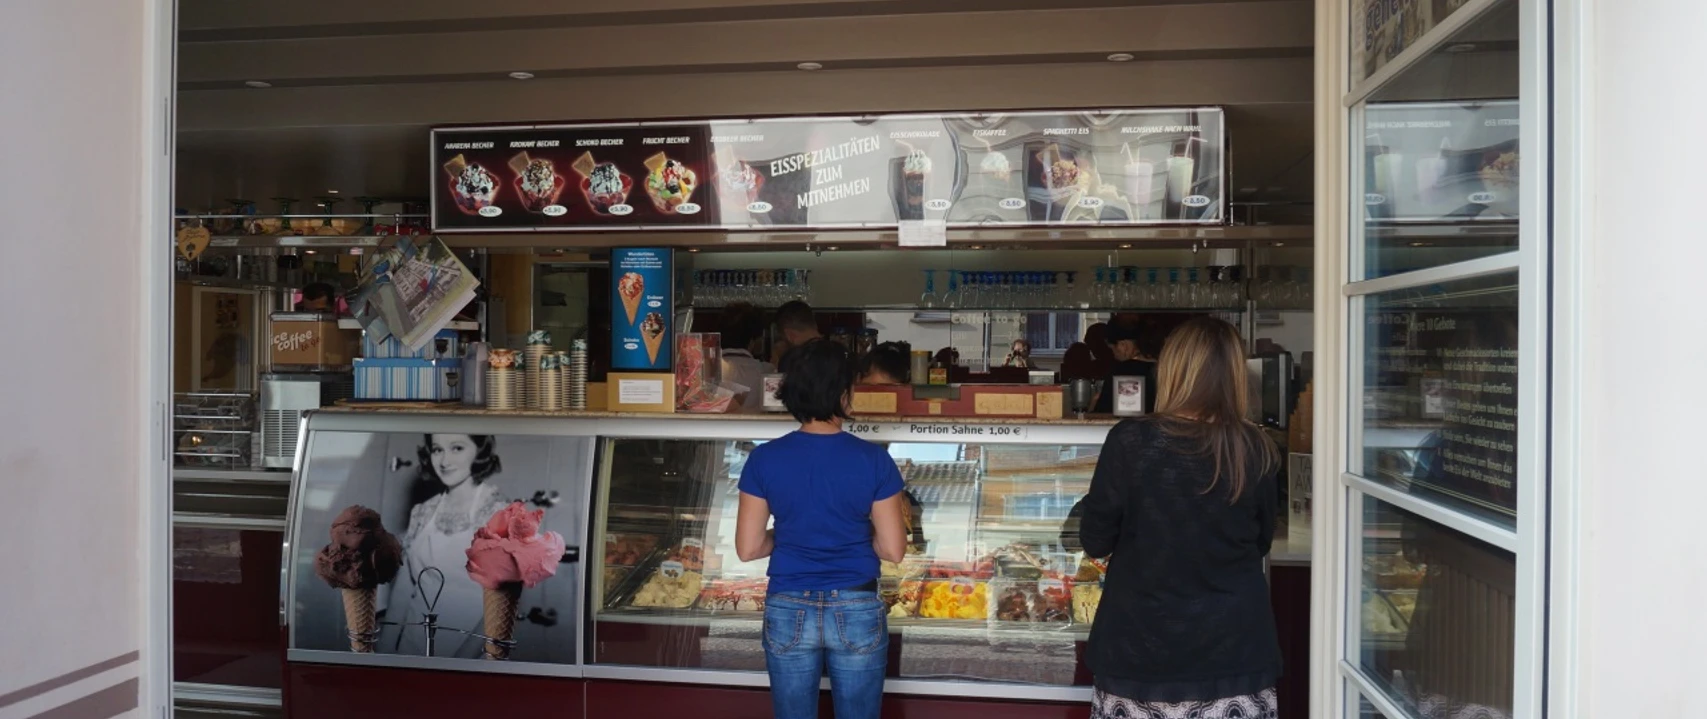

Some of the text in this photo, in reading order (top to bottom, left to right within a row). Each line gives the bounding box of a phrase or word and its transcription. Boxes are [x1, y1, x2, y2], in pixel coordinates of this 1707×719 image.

[1078, 127, 1090, 135] EIS
[642, 136, 690, 145] FRUCHT BECHER
[770, 134, 881, 177] EISSPEZIALITÄTEN
[816, 164, 843, 186] ZUM
[797, 177, 870, 209] MITNEHMEN
[951, 314, 990, 324] Coffee
[996, 315, 1008, 324] to
[277, 330, 313, 351] coffee
[872, 425, 880, 433] €
[910, 424, 1022, 436] Portion Sahne 1,00 €
